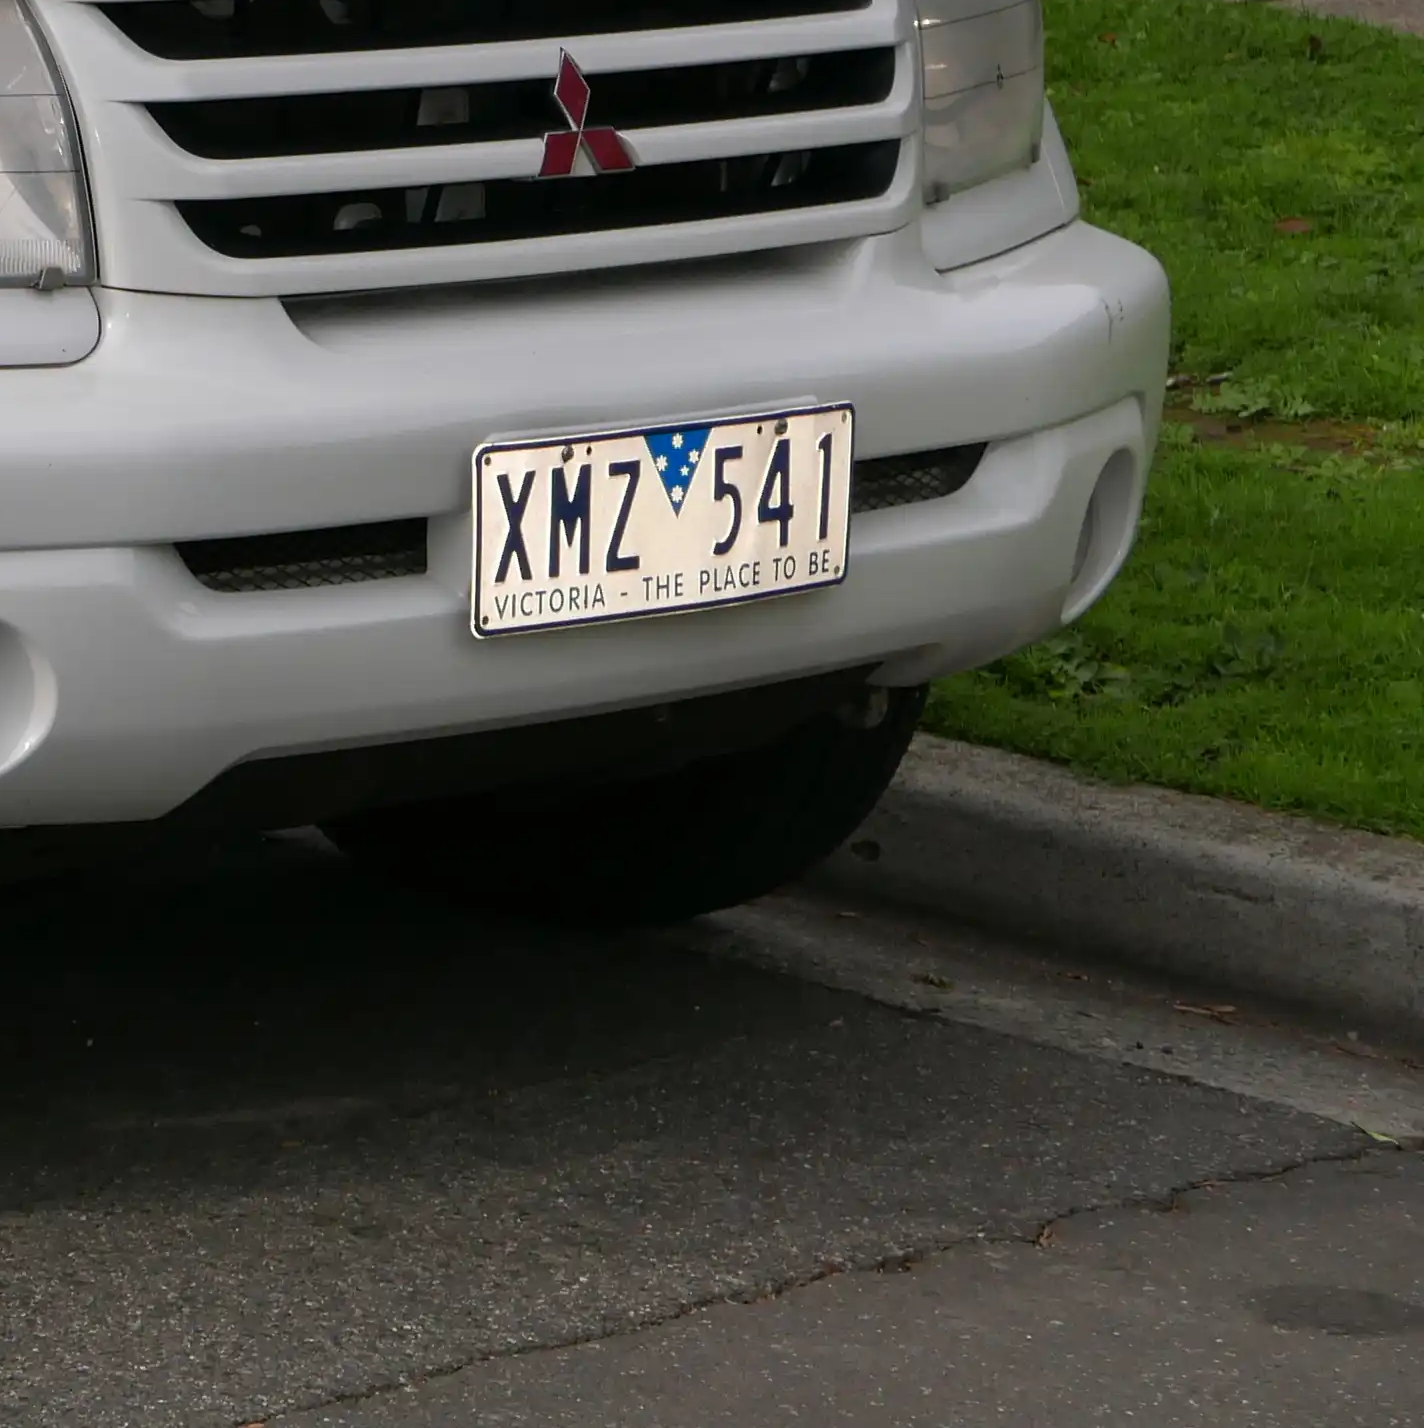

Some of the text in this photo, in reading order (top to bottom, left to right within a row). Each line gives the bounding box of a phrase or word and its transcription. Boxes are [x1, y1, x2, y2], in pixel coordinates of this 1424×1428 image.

[494, 432, 833, 584] XMZ 541
[494, 582, 606, 620] VICTORIA
[642, 573, 684, 601] THE
[699, 561, 761, 596] PLACE
[773, 555, 796, 581] TO
[808, 549, 831, 576] BE
